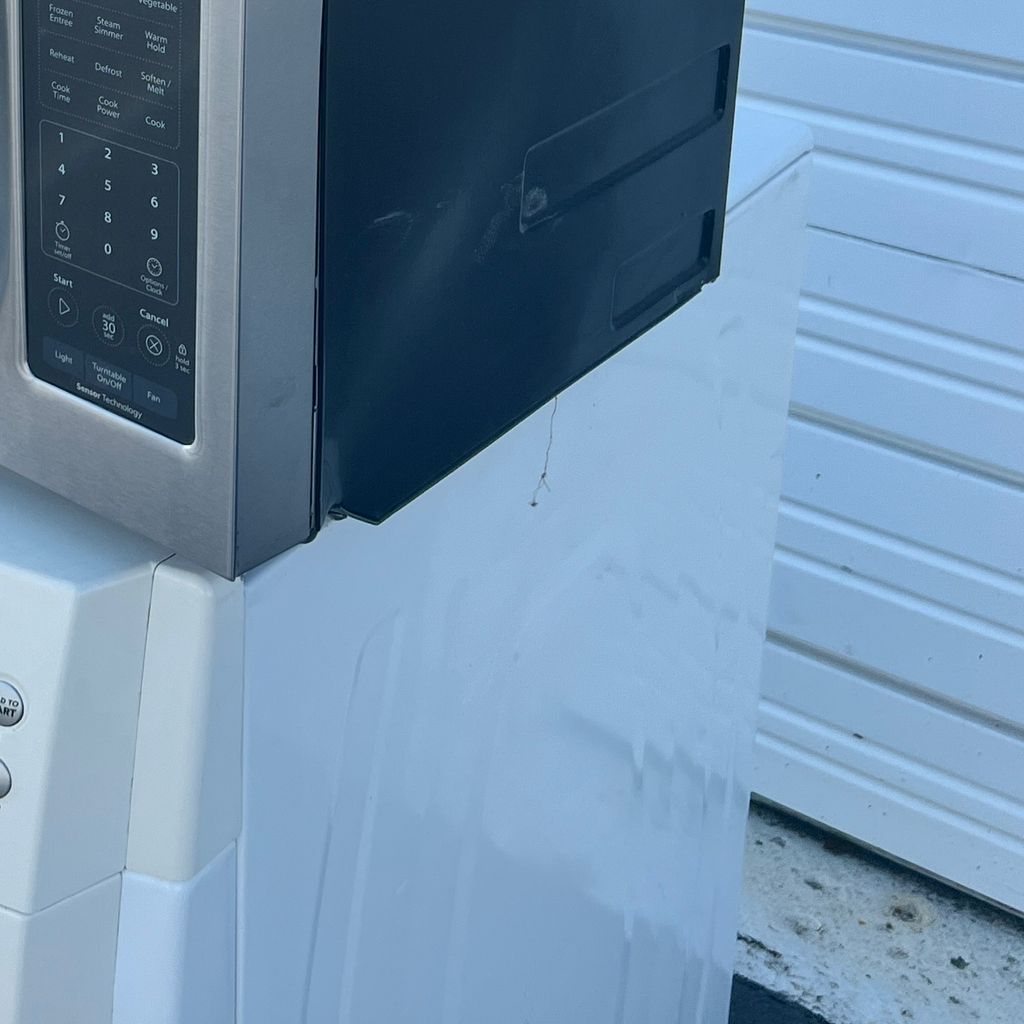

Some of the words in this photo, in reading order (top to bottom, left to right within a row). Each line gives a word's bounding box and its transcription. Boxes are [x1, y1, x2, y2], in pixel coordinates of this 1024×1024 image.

[49, 4, 74, 17] Frozen
[49, 14, 73, 27] Entree
[96, 16, 121, 30] Steam
[94, 25, 124, 40] Simmer
[145, 31, 168, 44] Warm
[147, 41, 166, 54] Hold
[49, 49, 75, 63] Reheat
[94, 62, 123, 78] Defrost
[141, 71, 166, 86] Soften
[51, 81, 71, 94] Cook
[147, 83, 165, 96] Melt
[53, 91, 71, 103] Time
[98, 96, 119, 109] Cook
[97, 105, 120, 119] Power
[145, 116, 167, 130] Cook
[59, 132, 64, 143] 1
[104, 147, 112, 160] 2
[58, 163, 66, 175] 4
[151, 163, 158, 175] 3
[104, 179, 112, 191] 5
[59, 194, 66, 206] 7
[150, 196, 159, 208] 6
[104, 211, 112, 223] 8
[150, 228, 158, 240] 9
[104, 243, 112, 255] 0
[53, 273, 74, 289] Start
[102, 313, 115, 322] add
[139, 308, 169, 327] Cancel
[102, 320, 116, 334] 30
[54, 350, 73, 365] Light
[92, 361, 127, 383] Turntable
[96, 374, 122, 391] On/Off
[76, 382, 101, 399] Sensor
[102, 393, 143, 419] Technology
[147, 391, 161, 403] Fan
[8, 698, 20, 708] TO
